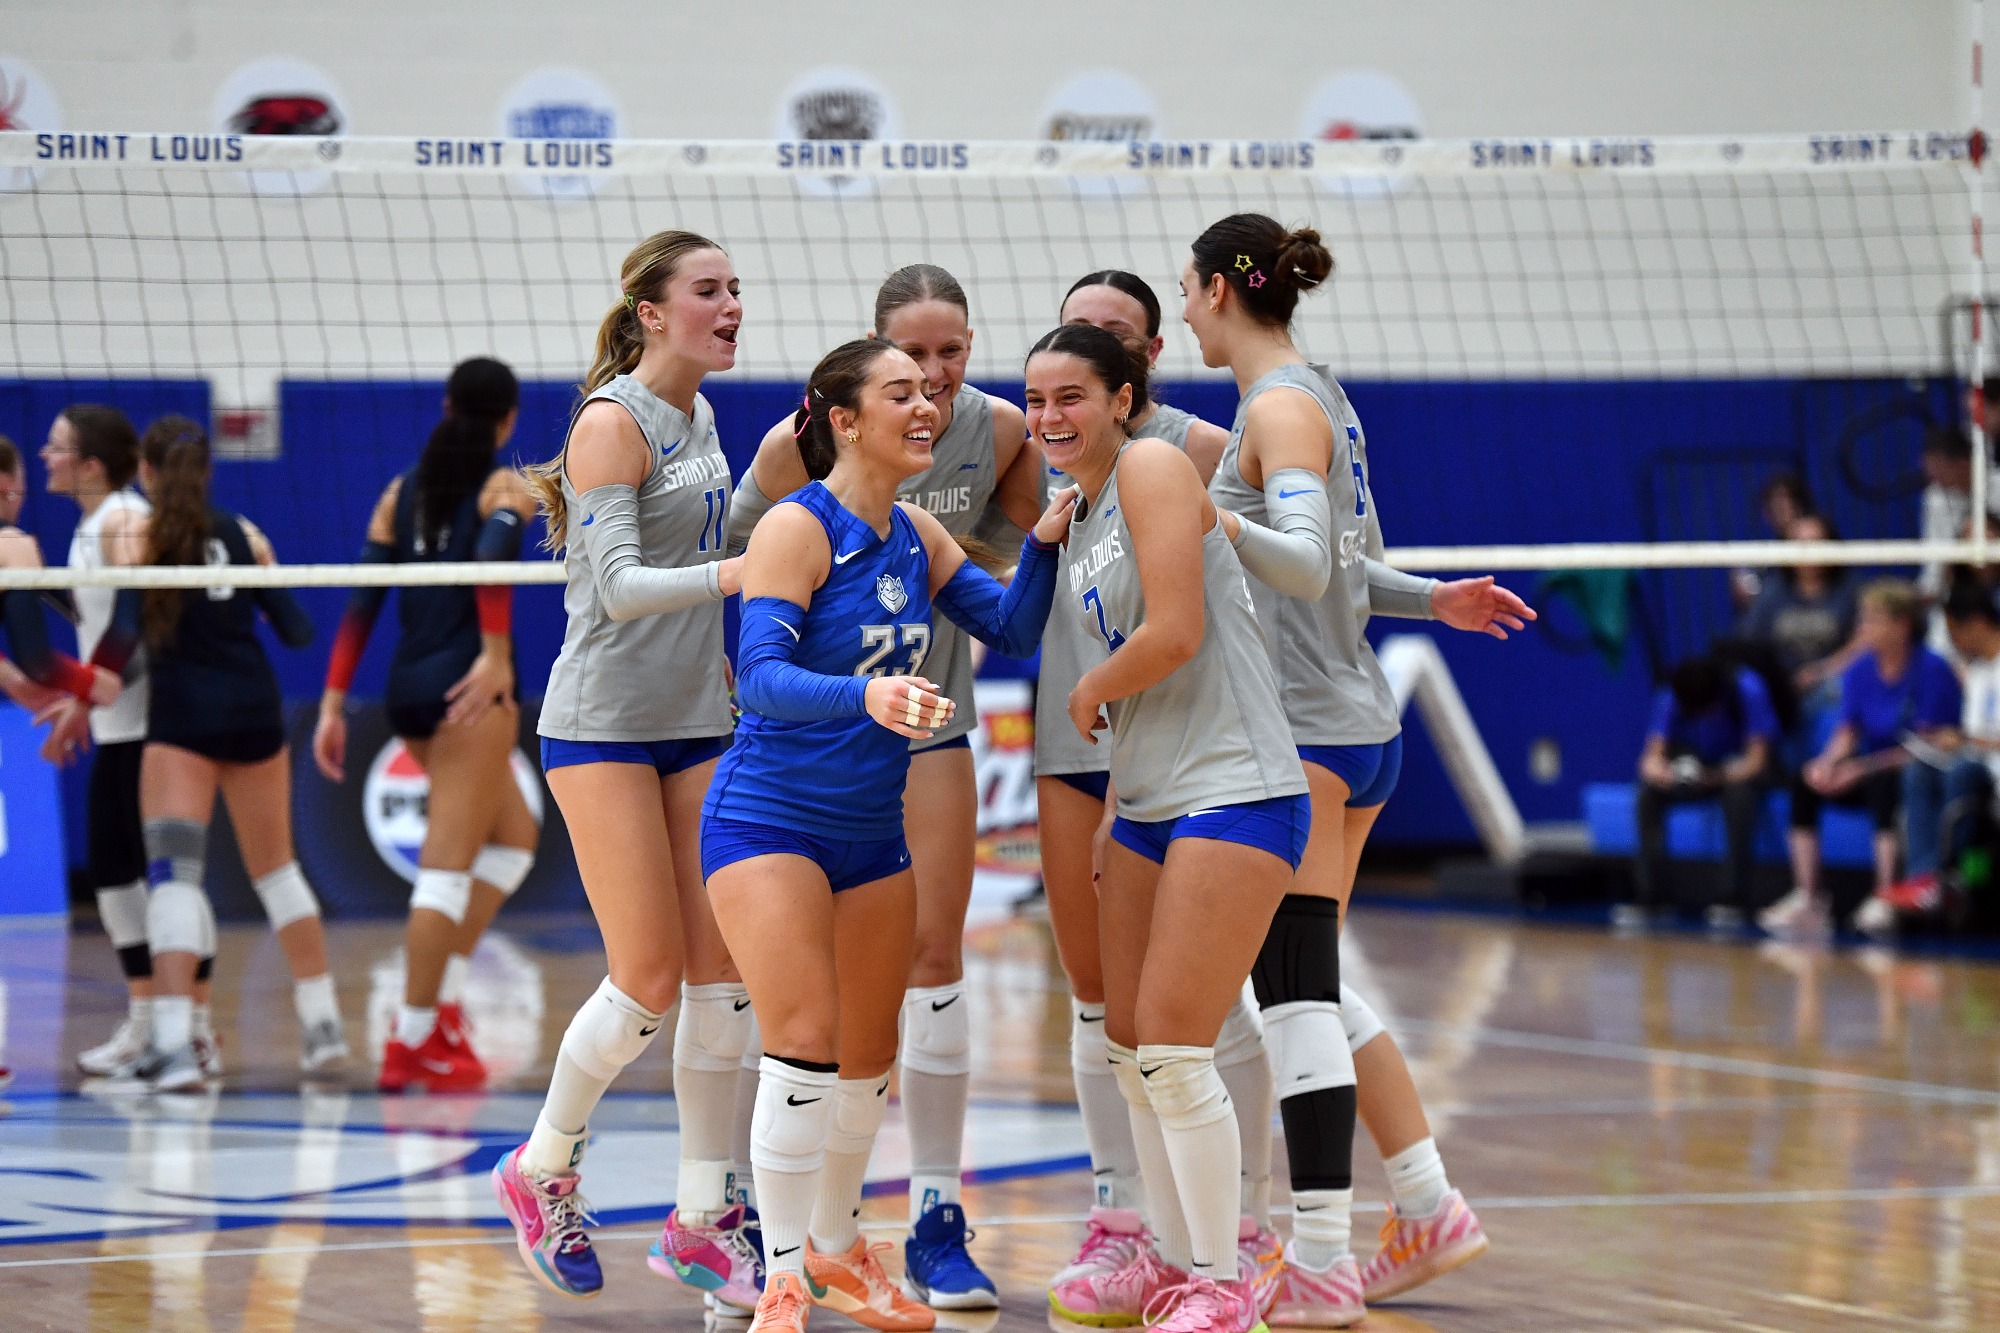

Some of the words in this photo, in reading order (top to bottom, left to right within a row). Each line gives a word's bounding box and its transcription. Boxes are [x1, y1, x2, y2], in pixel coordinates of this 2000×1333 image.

[37, 133, 130, 160] SAINT
[151, 136, 244, 162] LOUIS
[415, 140, 504, 166] SAINT
[524, 142, 614, 168] LOUIS
[777, 143, 862, 168] SAINT
[882, 144, 969, 169] LOUIS
[1127, 142, 1212, 168] SAINT
[1229, 142, 1315, 168] LOUIS
[1470, 139, 1552, 168] SAINT
[1570, 138, 1655, 168] LOUIS
[1808, 134, 1890, 164] SAINT
[662, 457, 708, 490] SAINT
[697, 486, 726, 553] 11
[1080, 584, 1127, 653] 2
[853, 623, 931, 678] 23
